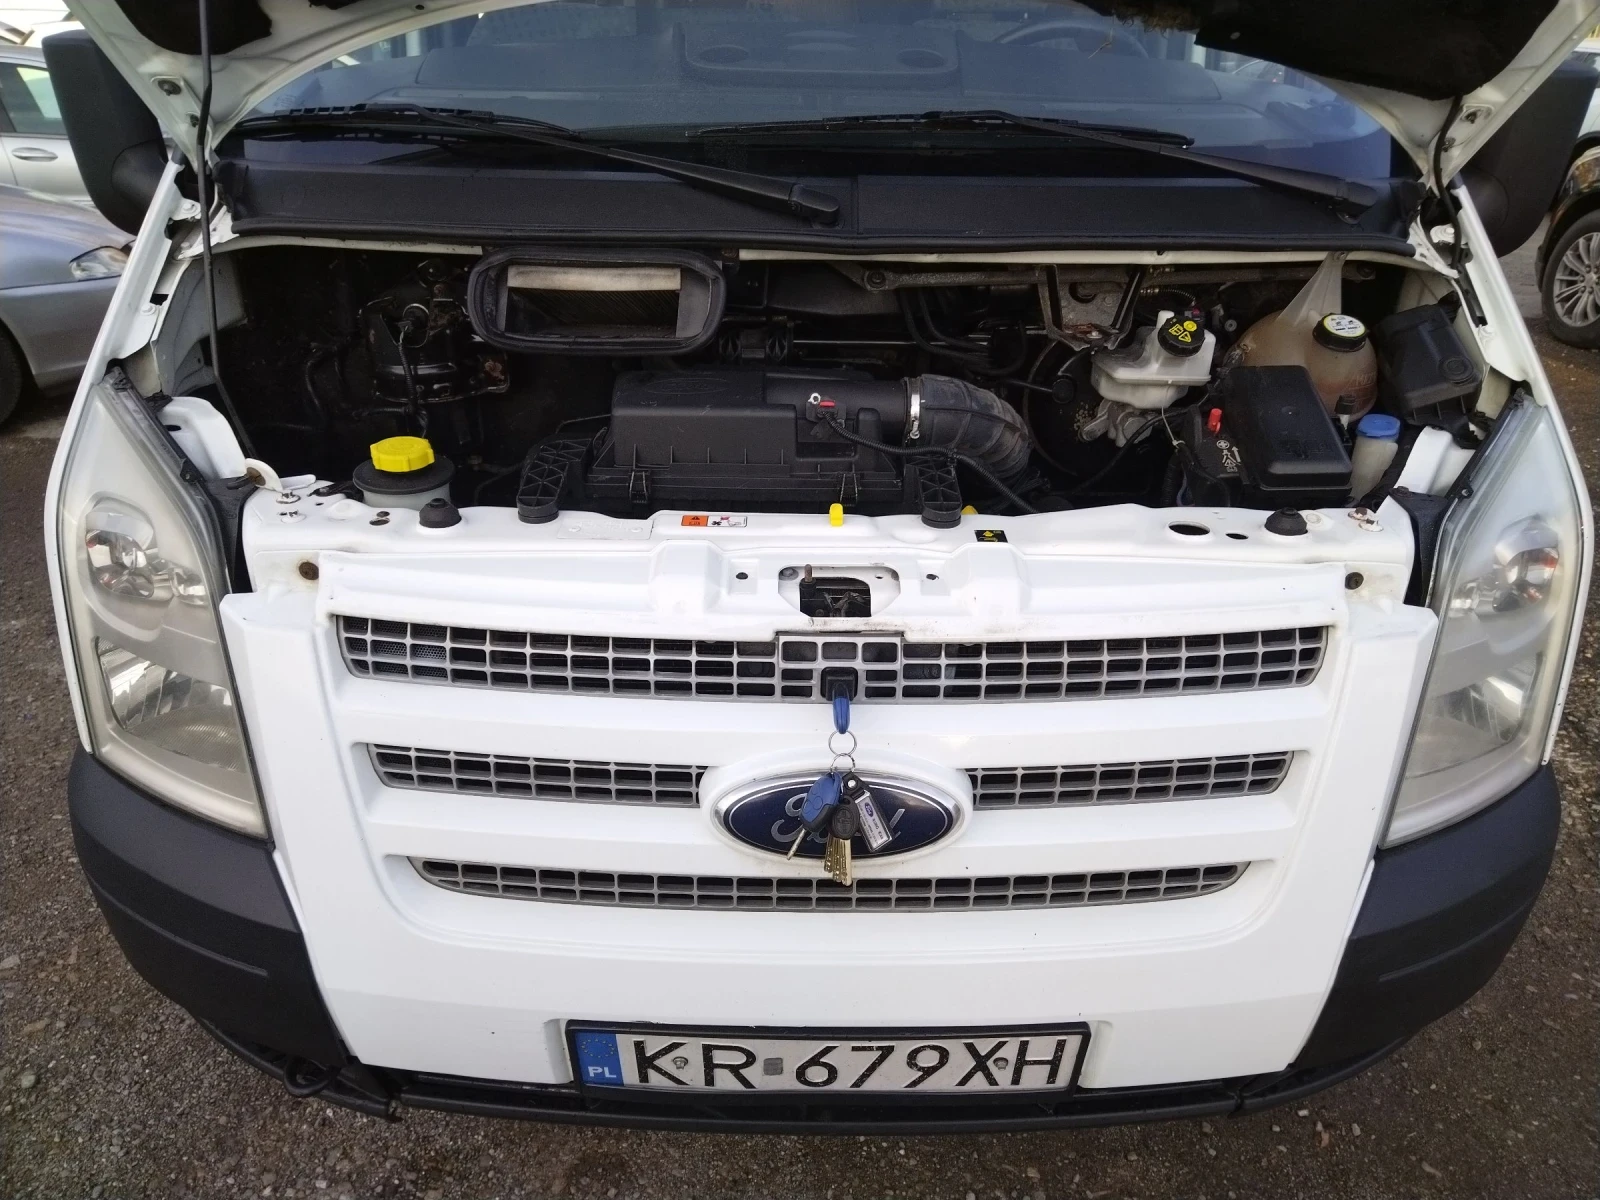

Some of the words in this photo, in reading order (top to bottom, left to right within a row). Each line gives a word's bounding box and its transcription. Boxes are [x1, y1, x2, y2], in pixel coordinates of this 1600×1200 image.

[587, 1066, 617, 1078] PL
[633, 1040, 757, 1089] KR
[795, 1039, 1067, 1088] 679XH
